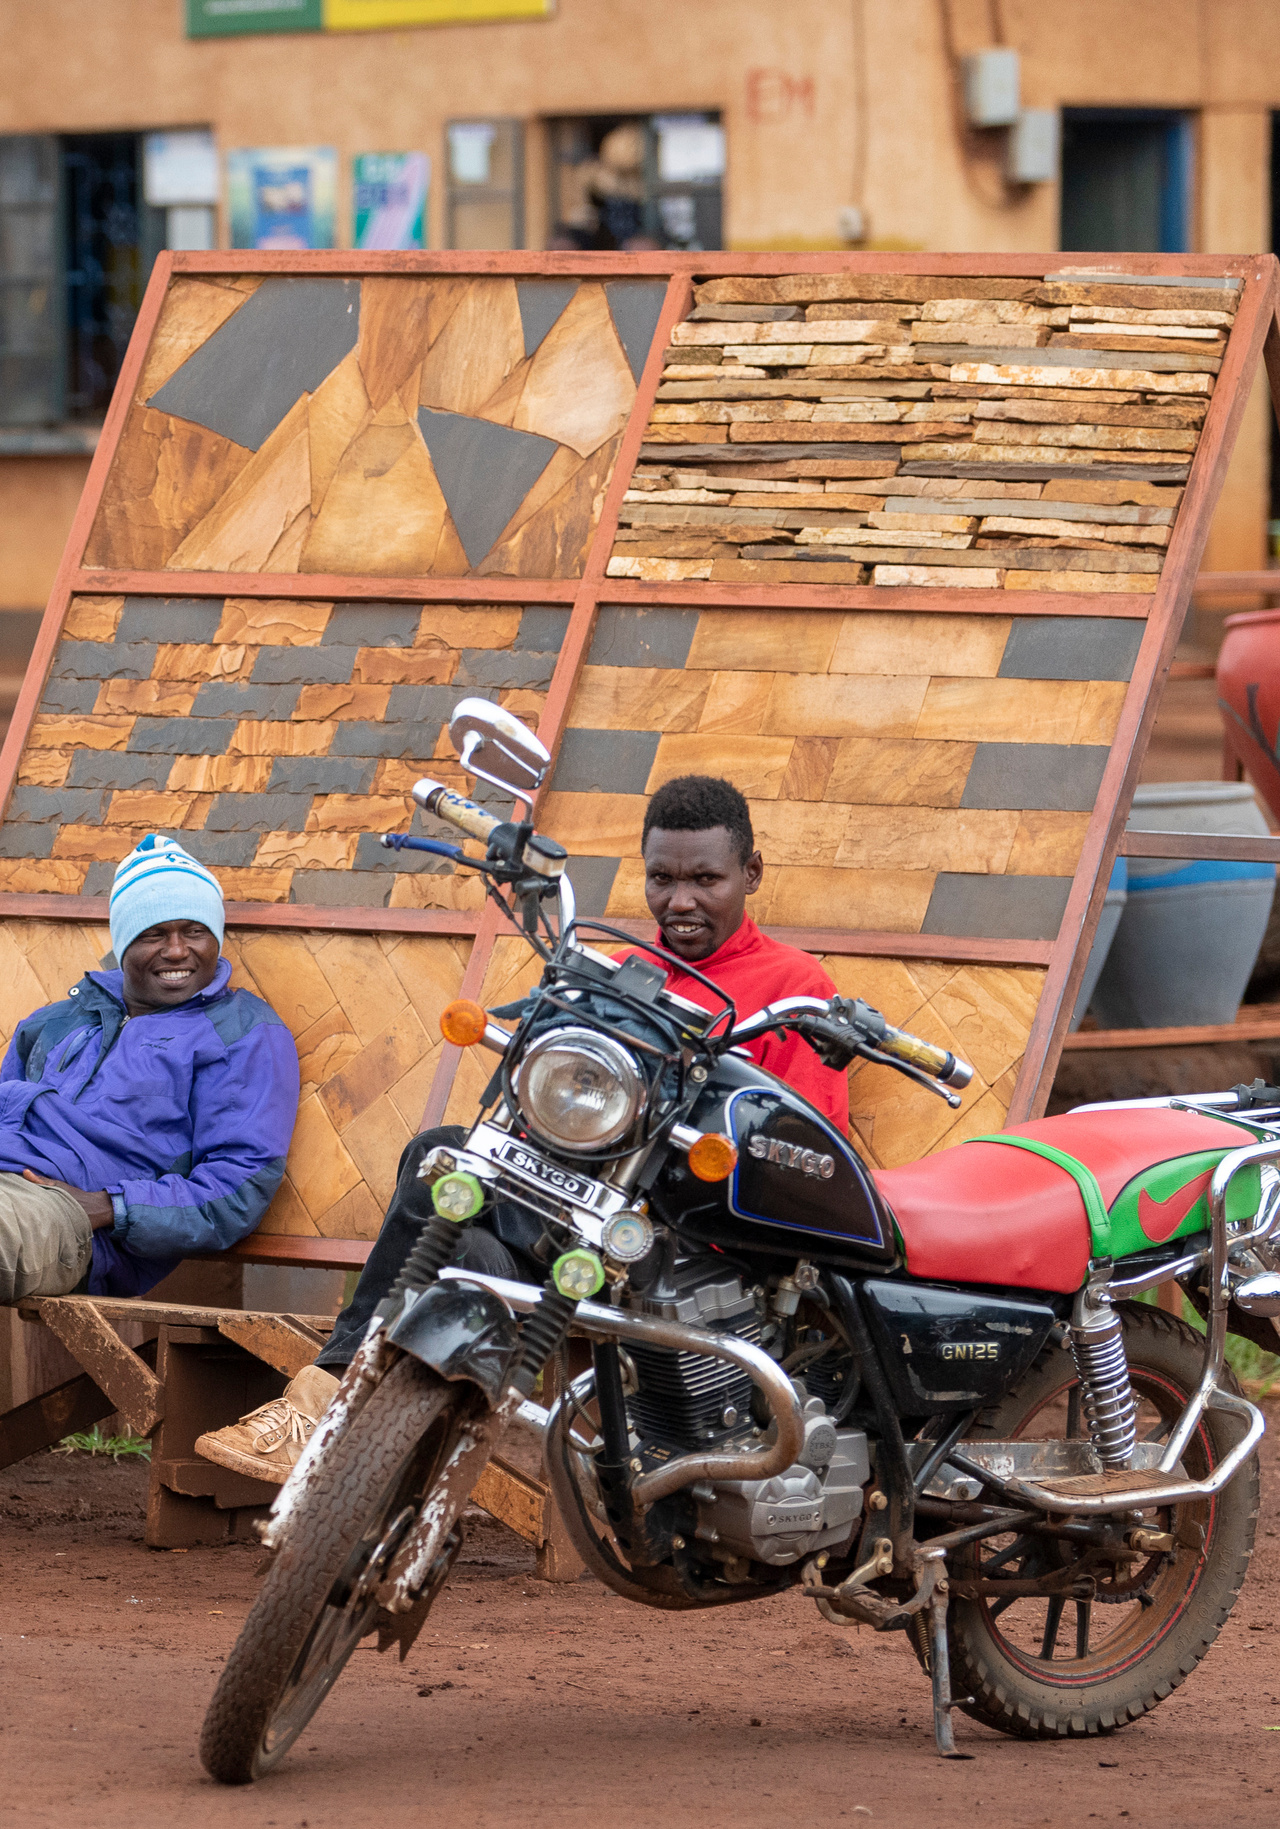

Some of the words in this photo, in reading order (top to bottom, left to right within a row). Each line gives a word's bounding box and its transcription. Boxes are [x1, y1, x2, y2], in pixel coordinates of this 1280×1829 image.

[748, 1134, 836, 1179] SKYGO
[513, 1151, 580, 1193] SKYGO
[941, 1343, 999, 1360] GN125
[778, 1513, 812, 1523] SKYGO
